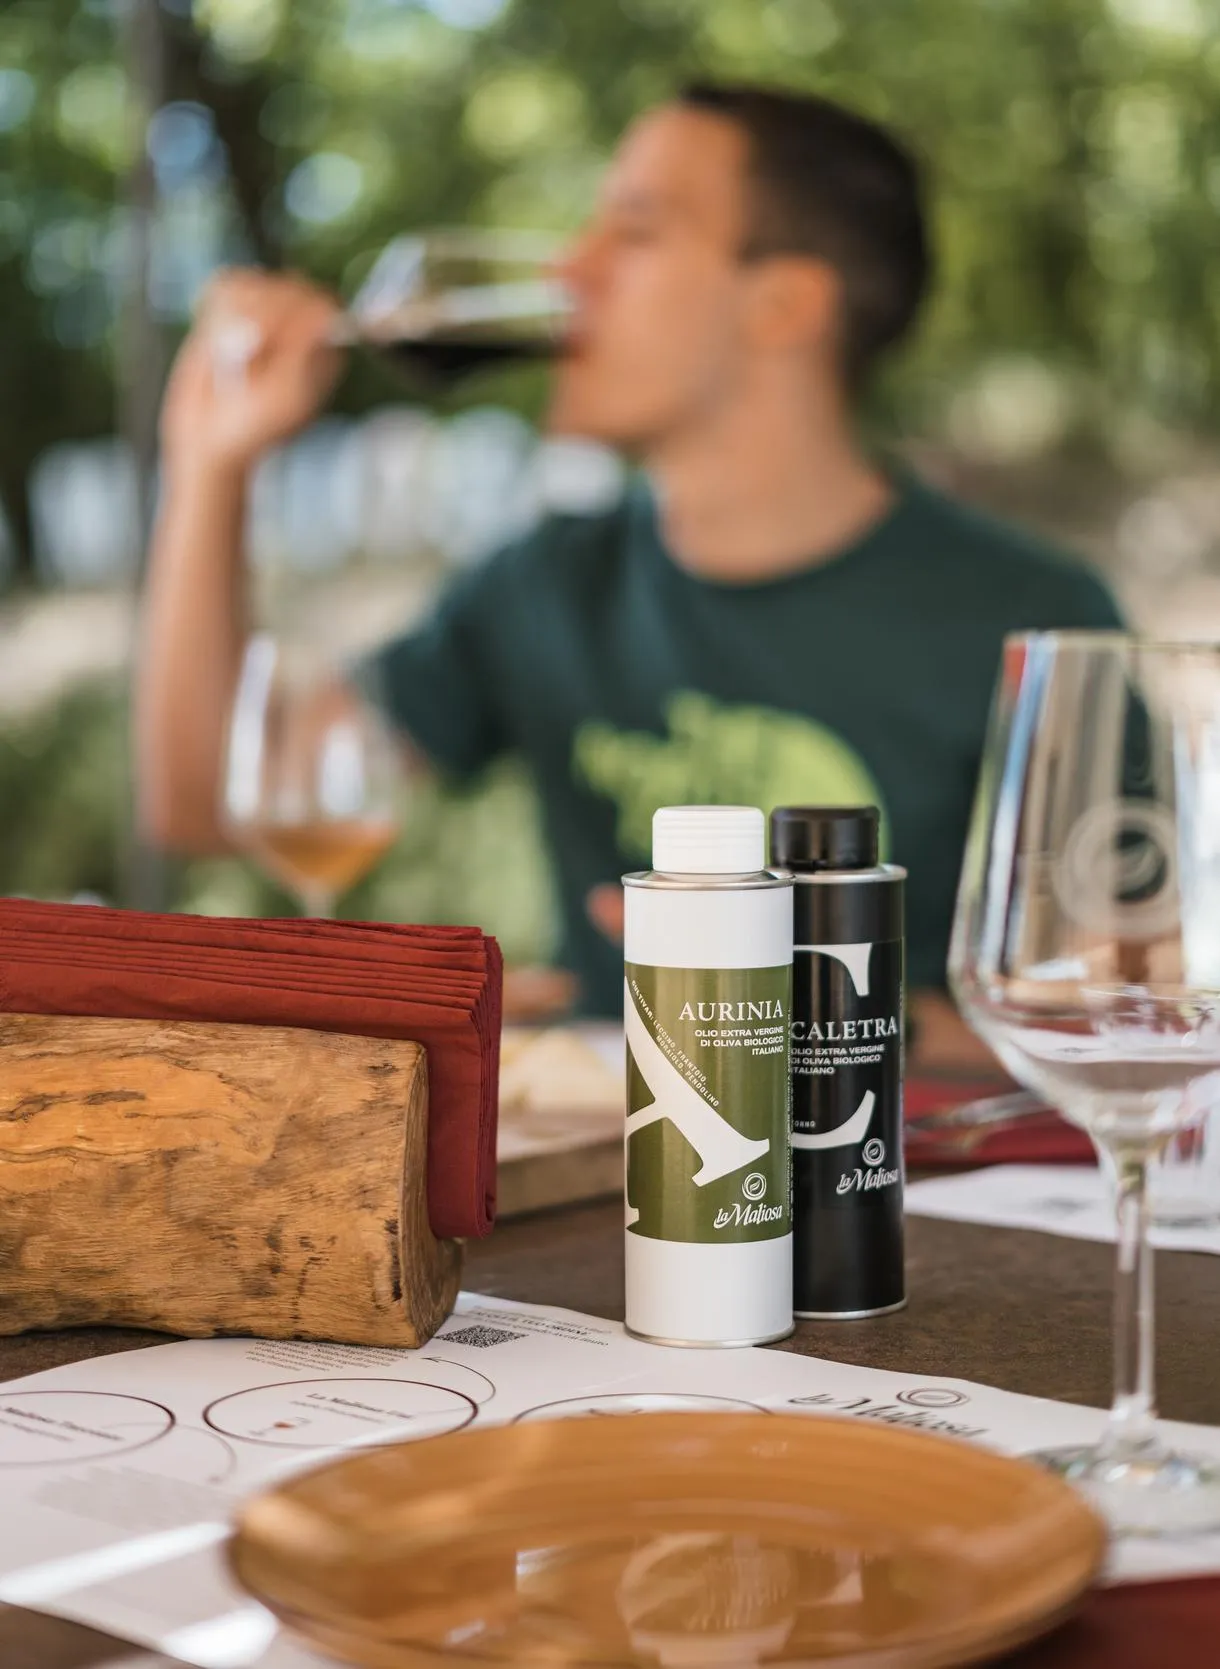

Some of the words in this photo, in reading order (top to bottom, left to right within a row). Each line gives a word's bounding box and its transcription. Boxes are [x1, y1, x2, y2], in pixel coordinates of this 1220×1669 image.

[678, 999, 784, 1022] AURINIA
[694, 1029, 719, 1038] OLIO
[720, 1029, 752, 1038] EXTRA
[753, 1025, 784, 1037] VERGINE
[791, 1015, 899, 1041] CALETRA
[700, 1039, 711, 1048] DI
[713, 1039, 742, 1048] OLIVA
[743, 1035, 784, 1048] BIOLOGICO
[752, 1045, 784, 1057] ITALIANO
[791, 1047, 813, 1056] OLIO
[814, 1046, 848, 1056] EXTRA
[848, 1043, 885, 1055] VERGINE
[802, 1056, 832, 1066] OLIVA
[832, 1053, 882, 1066] BIOLOGICO
[685, 1071, 720, 1107] PENDOLINO
[713, 1207, 730, 1229] la
[730, 1202, 784, 1227] Maliosa
